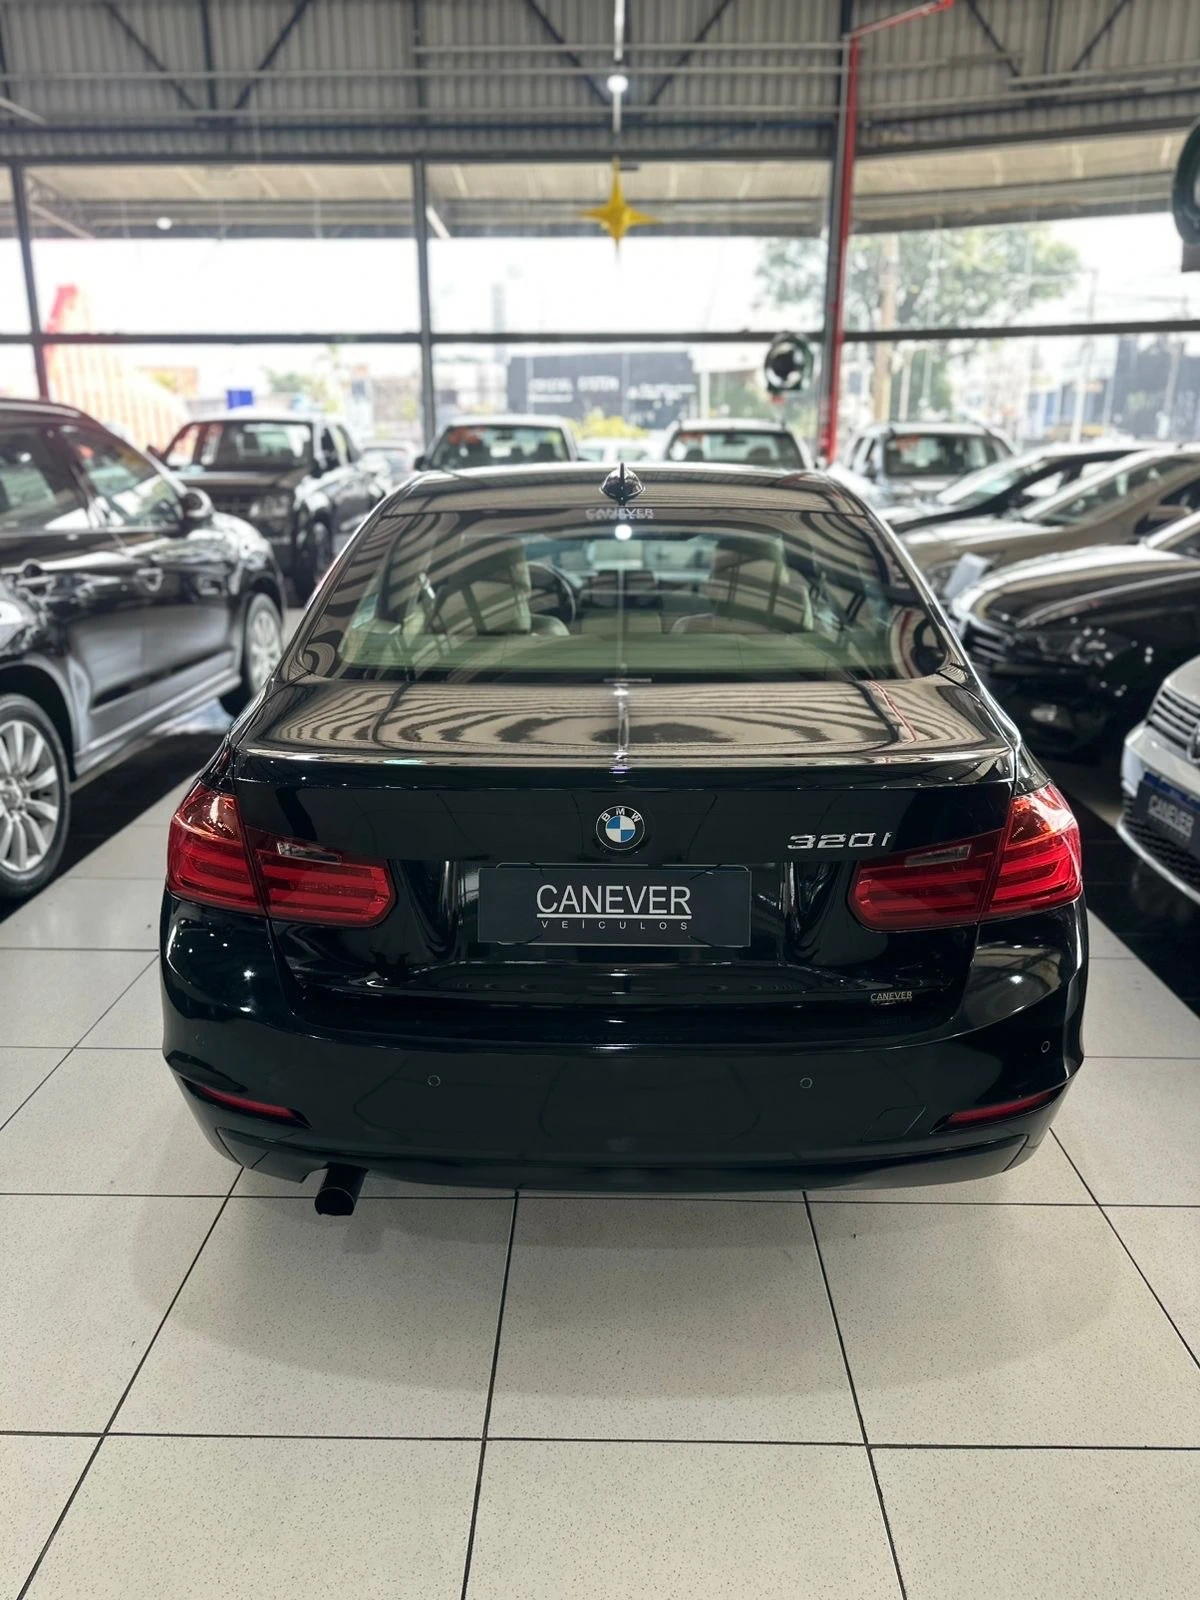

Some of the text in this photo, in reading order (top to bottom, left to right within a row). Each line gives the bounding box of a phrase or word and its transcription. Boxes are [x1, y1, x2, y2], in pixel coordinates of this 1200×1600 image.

[601, 807, 641, 822] BMW
[787, 832, 893, 850] 320i
[536, 884, 692, 914] CANEVER
[870, 991, 913, 1001] CANEVER
